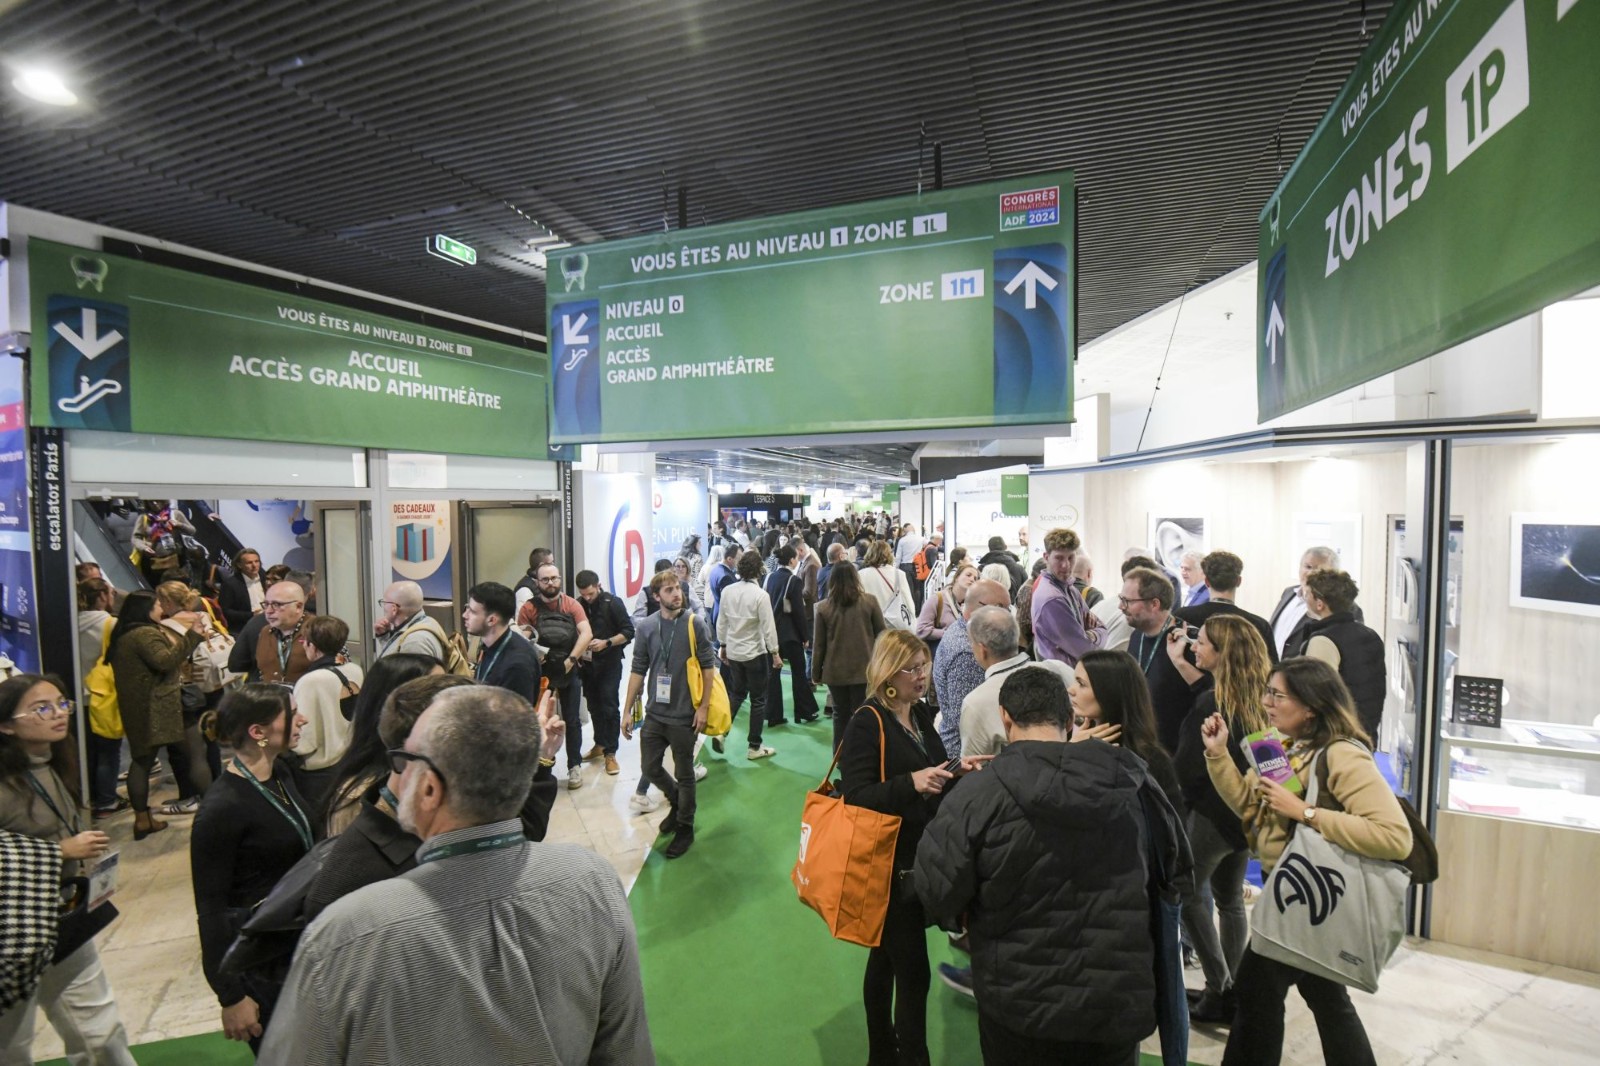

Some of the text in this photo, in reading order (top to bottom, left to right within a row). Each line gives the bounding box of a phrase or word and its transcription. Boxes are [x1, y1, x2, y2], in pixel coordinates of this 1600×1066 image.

[1341, 82, 1368, 137] VOUS
[1371, 37, 1400, 98] ÊTES
[1403, 2, 1423, 54] AU
[1324, 47, 1506, 279] ZONES 1P
[1004, 190, 1056, 206] CONGRÈS
[1004, 211, 1056, 227] ADF 2024
[631, 253, 677, 273] VOUS
[681, 245, 721, 267] ÊTES
[726, 241, 751, 261] AU
[756, 231, 825, 257] NIVEAU
[853, 219, 907, 244] ZONE
[879, 281, 934, 304] ZONE
[606, 298, 664, 320] NIVEAU
[277, 306, 316, 325] VOUS
[319, 312, 350, 332] ÊTES
[353, 323, 370, 336] AU
[373, 326, 414, 344] NIVEAU
[428, 338, 455, 353] ZONE
[606, 322, 664, 342] ACCUEIL
[348, 350, 422, 378] ACCUEIL
[606, 345, 651, 365] ACCÈS
[606, 355, 775, 384] GRAND AMPHITHÉÂTRE
[229, 355, 502, 410] ACCÈS GRAND AMPHITHÉÂTRE
[43, 442, 59, 481] Paris
[46, 483, 61, 551] escalator
[393, 503, 435, 513] DES CADEAUX
[1273, 852, 1346, 926] ADF
